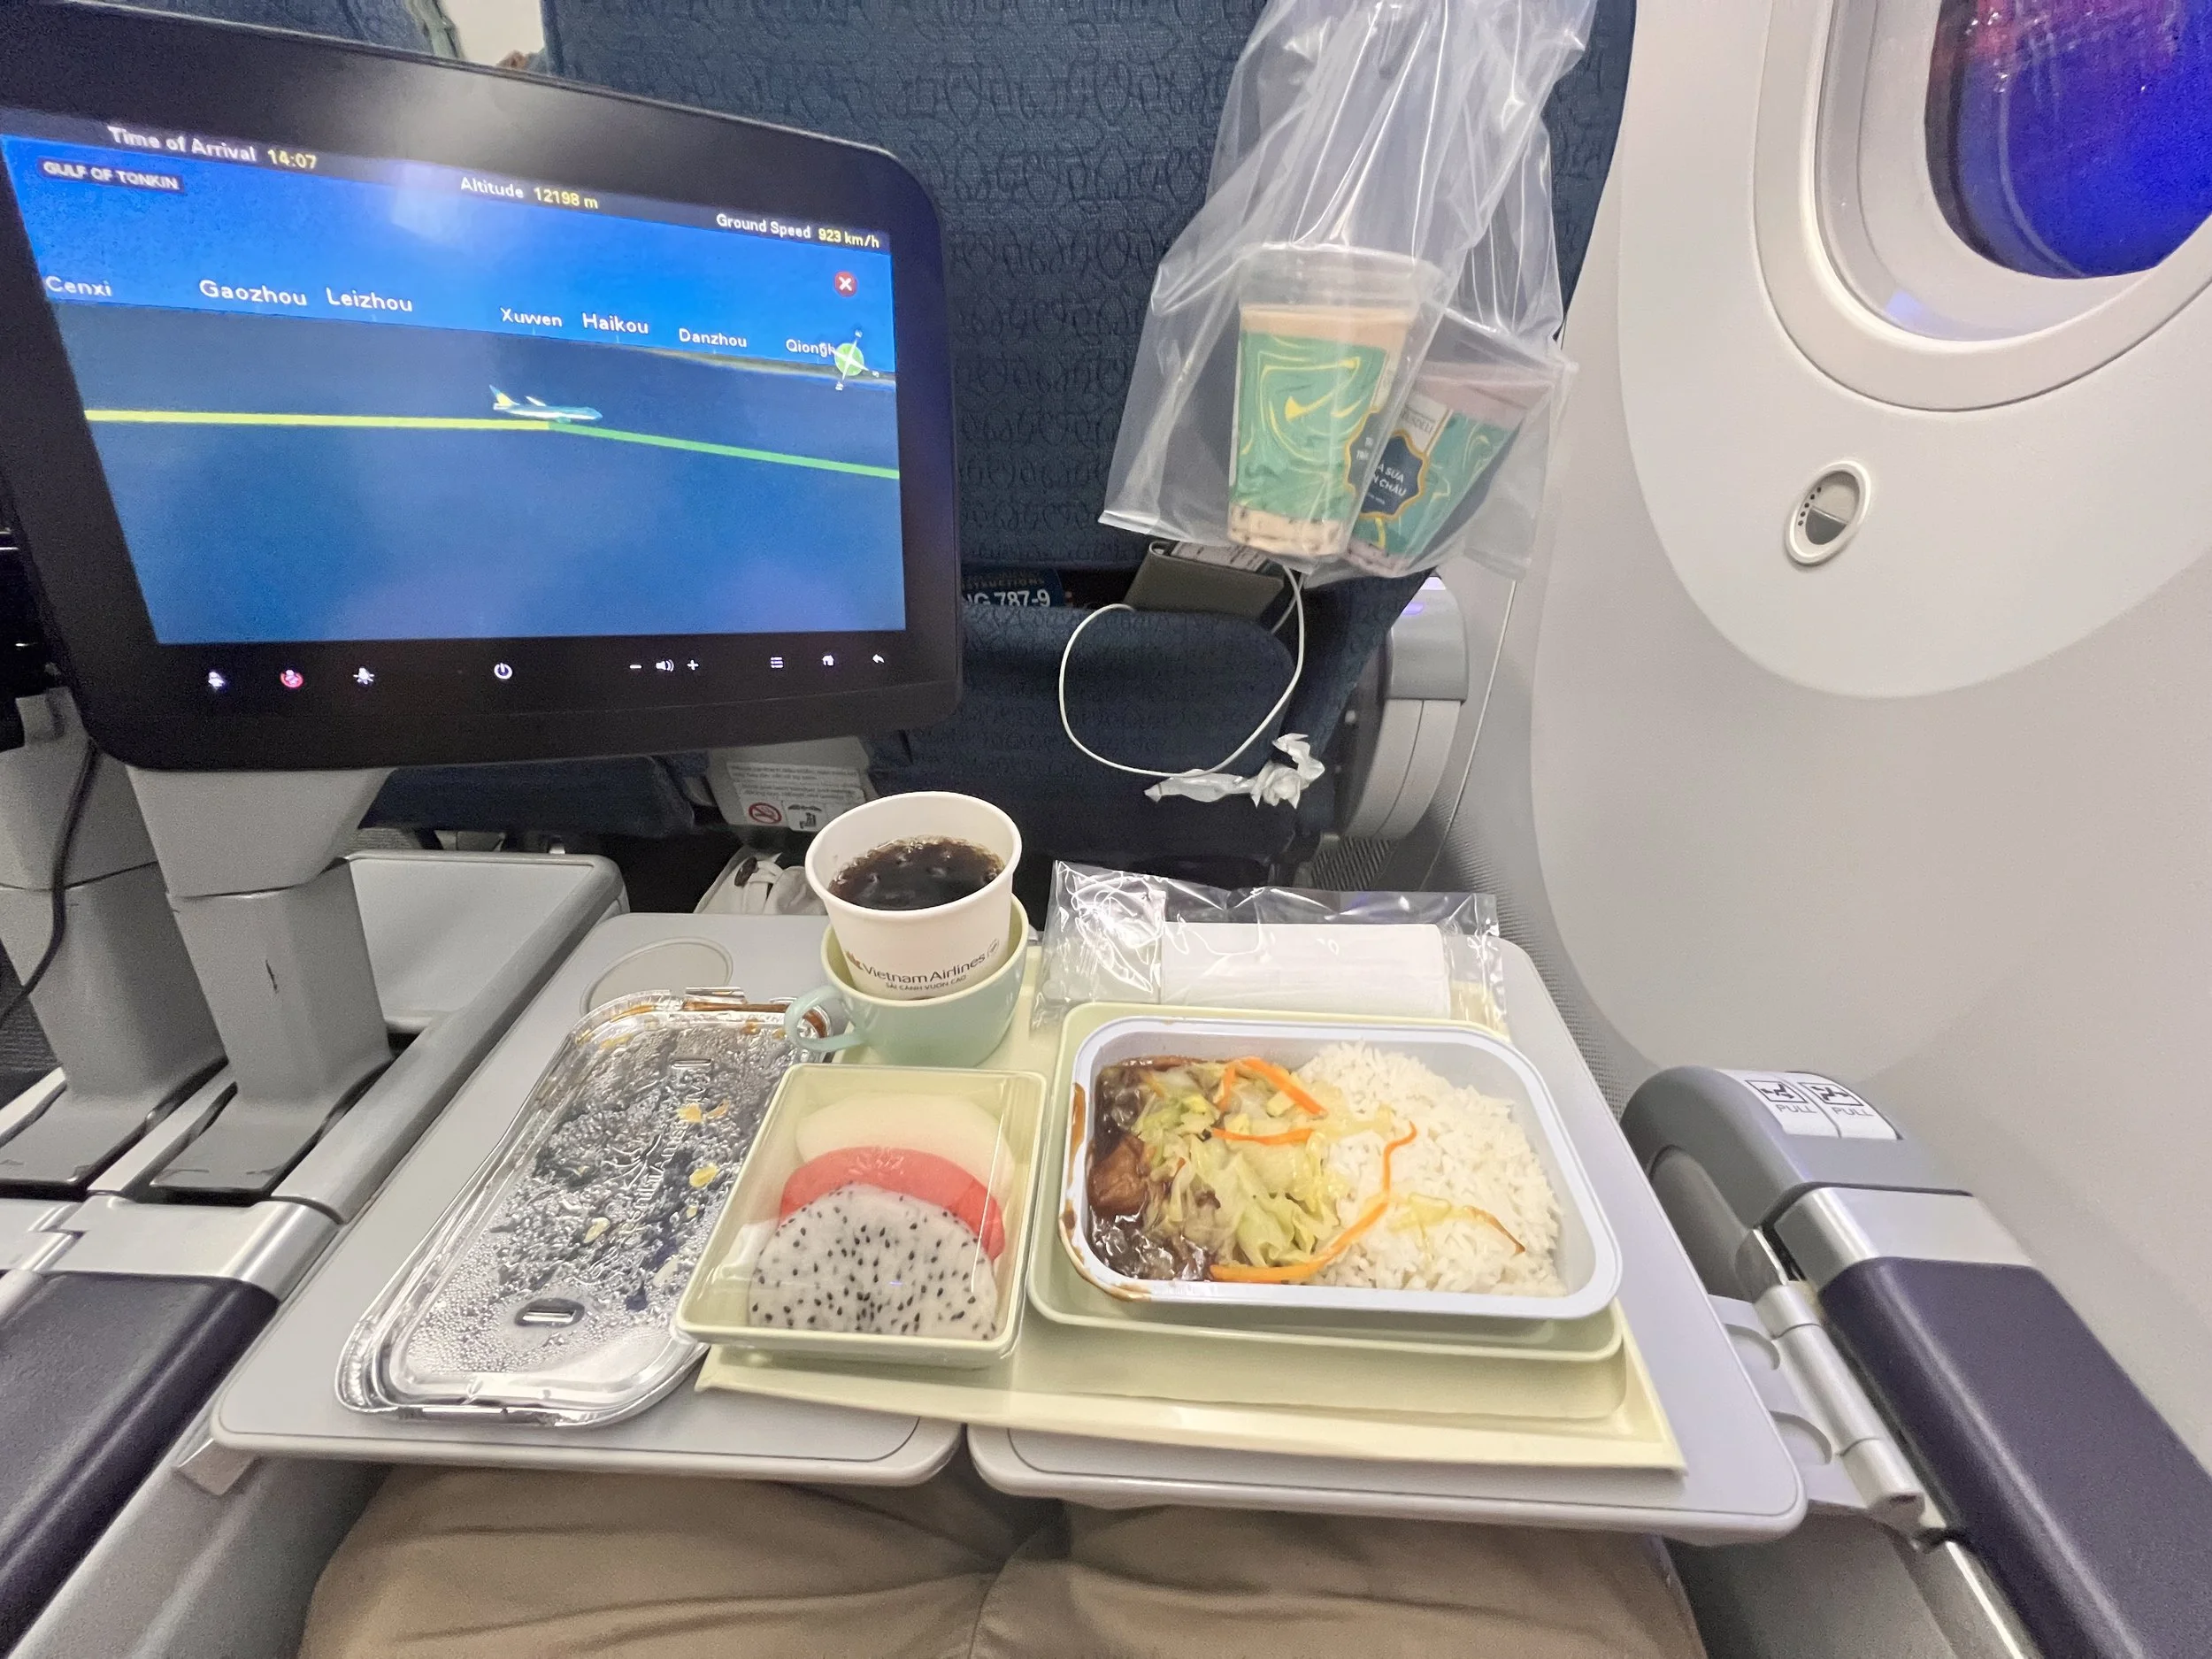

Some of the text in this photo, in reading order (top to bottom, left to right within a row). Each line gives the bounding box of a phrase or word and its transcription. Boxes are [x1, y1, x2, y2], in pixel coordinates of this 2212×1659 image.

[107, 126, 317, 169] Time of Arrival 14:07
[42, 160, 180, 190] GULF OF TONKIN
[460, 176, 599, 209] Altitude 12198 m
[716, 213, 879, 249] Ground Speed 923 km/h
[45, 275, 113, 297] Cenxi
[198, 279, 308, 306] Gaozhou
[326, 286, 413, 312] Leizhou
[500, 307, 563, 327] Xuwen
[581, 311, 649, 334] Haikou
[679, 327, 748, 348] Danzhou
[994, 588, 1051, 608] 787-9
[862, 953, 986, 984] Vietnam Airlines
[1775, 1103, 1817, 1114] PULL
[1832, 1107, 1874, 1117] PULL
